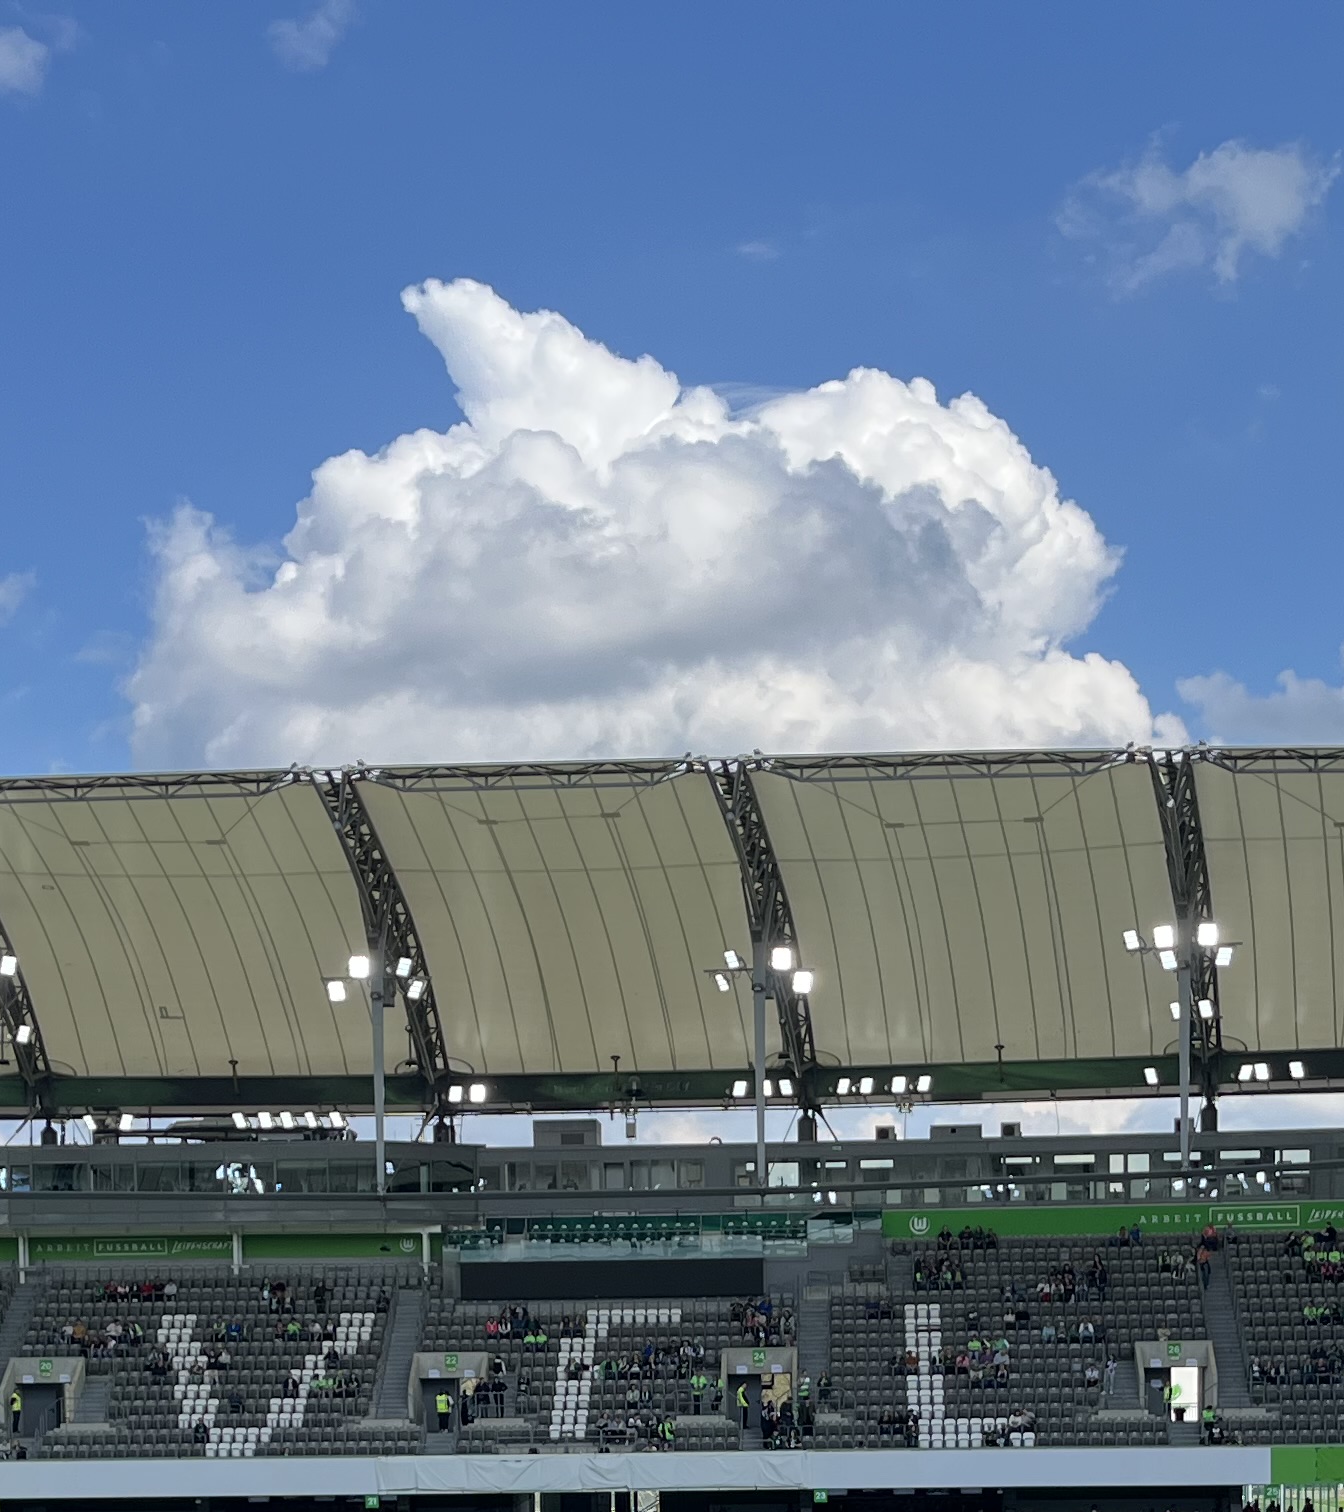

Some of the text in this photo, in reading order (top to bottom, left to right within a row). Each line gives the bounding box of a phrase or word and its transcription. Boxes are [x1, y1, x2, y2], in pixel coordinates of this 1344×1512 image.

[1139, 1213, 1202, 1224] ARBEIT
[1217, 1210, 1293, 1222] FUSSBALL
[98, 1242, 164, 1251] FUSSBALL
[445, 1356, 457, 1365] 22
[753, 1352, 765, 1361] 24
[816, 1491, 826, 1500] 23
[367, 1497, 377, 1505] 21
